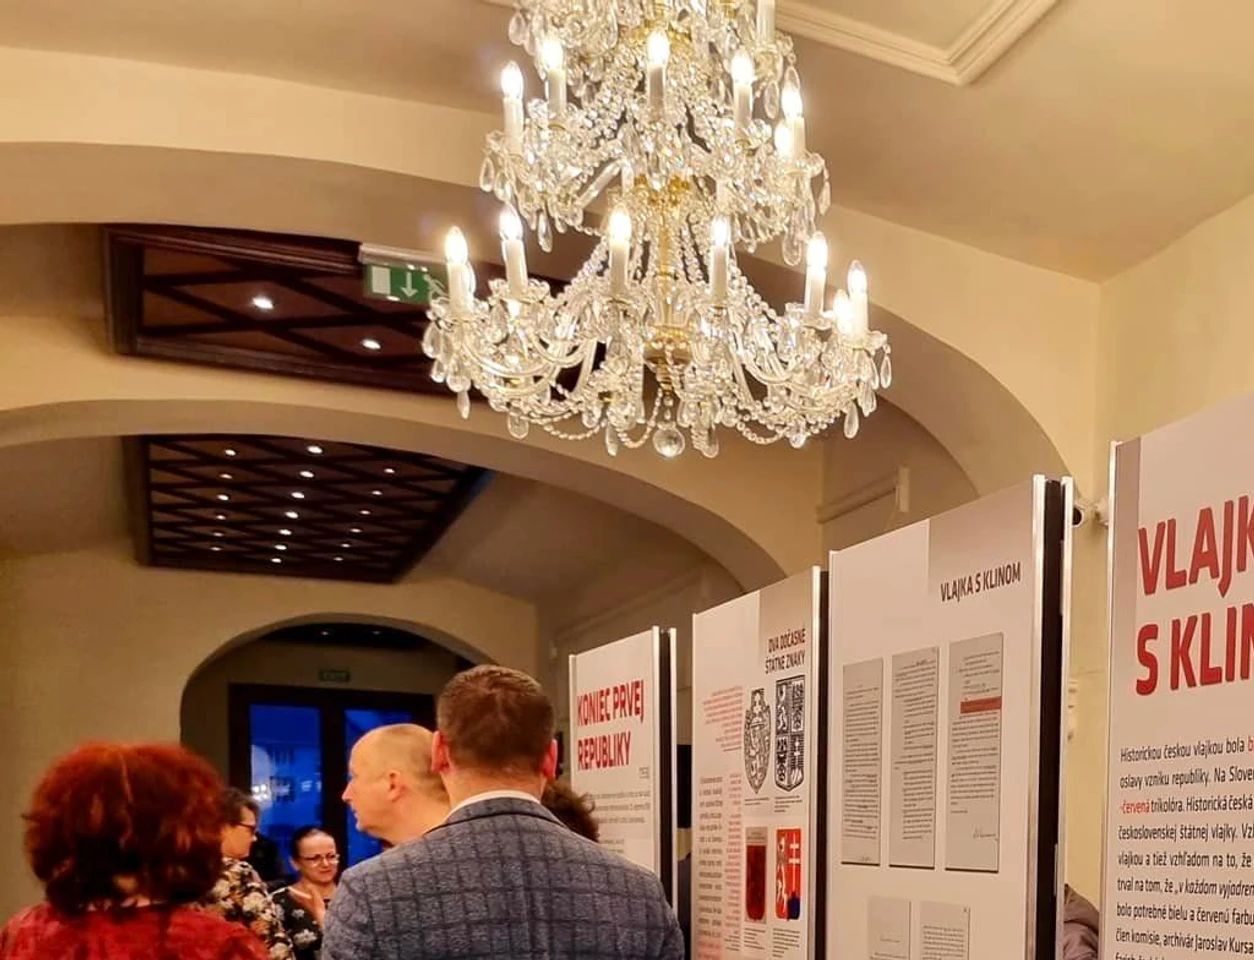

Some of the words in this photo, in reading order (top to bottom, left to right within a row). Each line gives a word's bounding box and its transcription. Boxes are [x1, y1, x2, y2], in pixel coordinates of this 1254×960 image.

[940, 576, 973, 603] VLAJKA
[976, 576, 981, 593] S
[983, 562, 1021, 590] KLINOM
[766, 655, 785, 673] ŠTÁTNE
[786, 650, 805, 670] ZNAKY
[1136, 624, 1159, 696] S
[577, 688, 610, 725] KONIEC
[613, 680, 643, 723] PRVEJ
[578, 731, 630, 771] REPUBLIKY
[1164, 744, 1191, 759] českou
[1194, 741, 1223, 756] vlajkou
[1226, 737, 1244, 753] bola
[1214, 767, 1225, 783] Na
[1186, 795, 1227, 811] Historická
[1229, 794, 1253, 810] česká
[1232, 908, 1254, 925] farbu
[1195, 935, 1227, 951] Jaroslav
